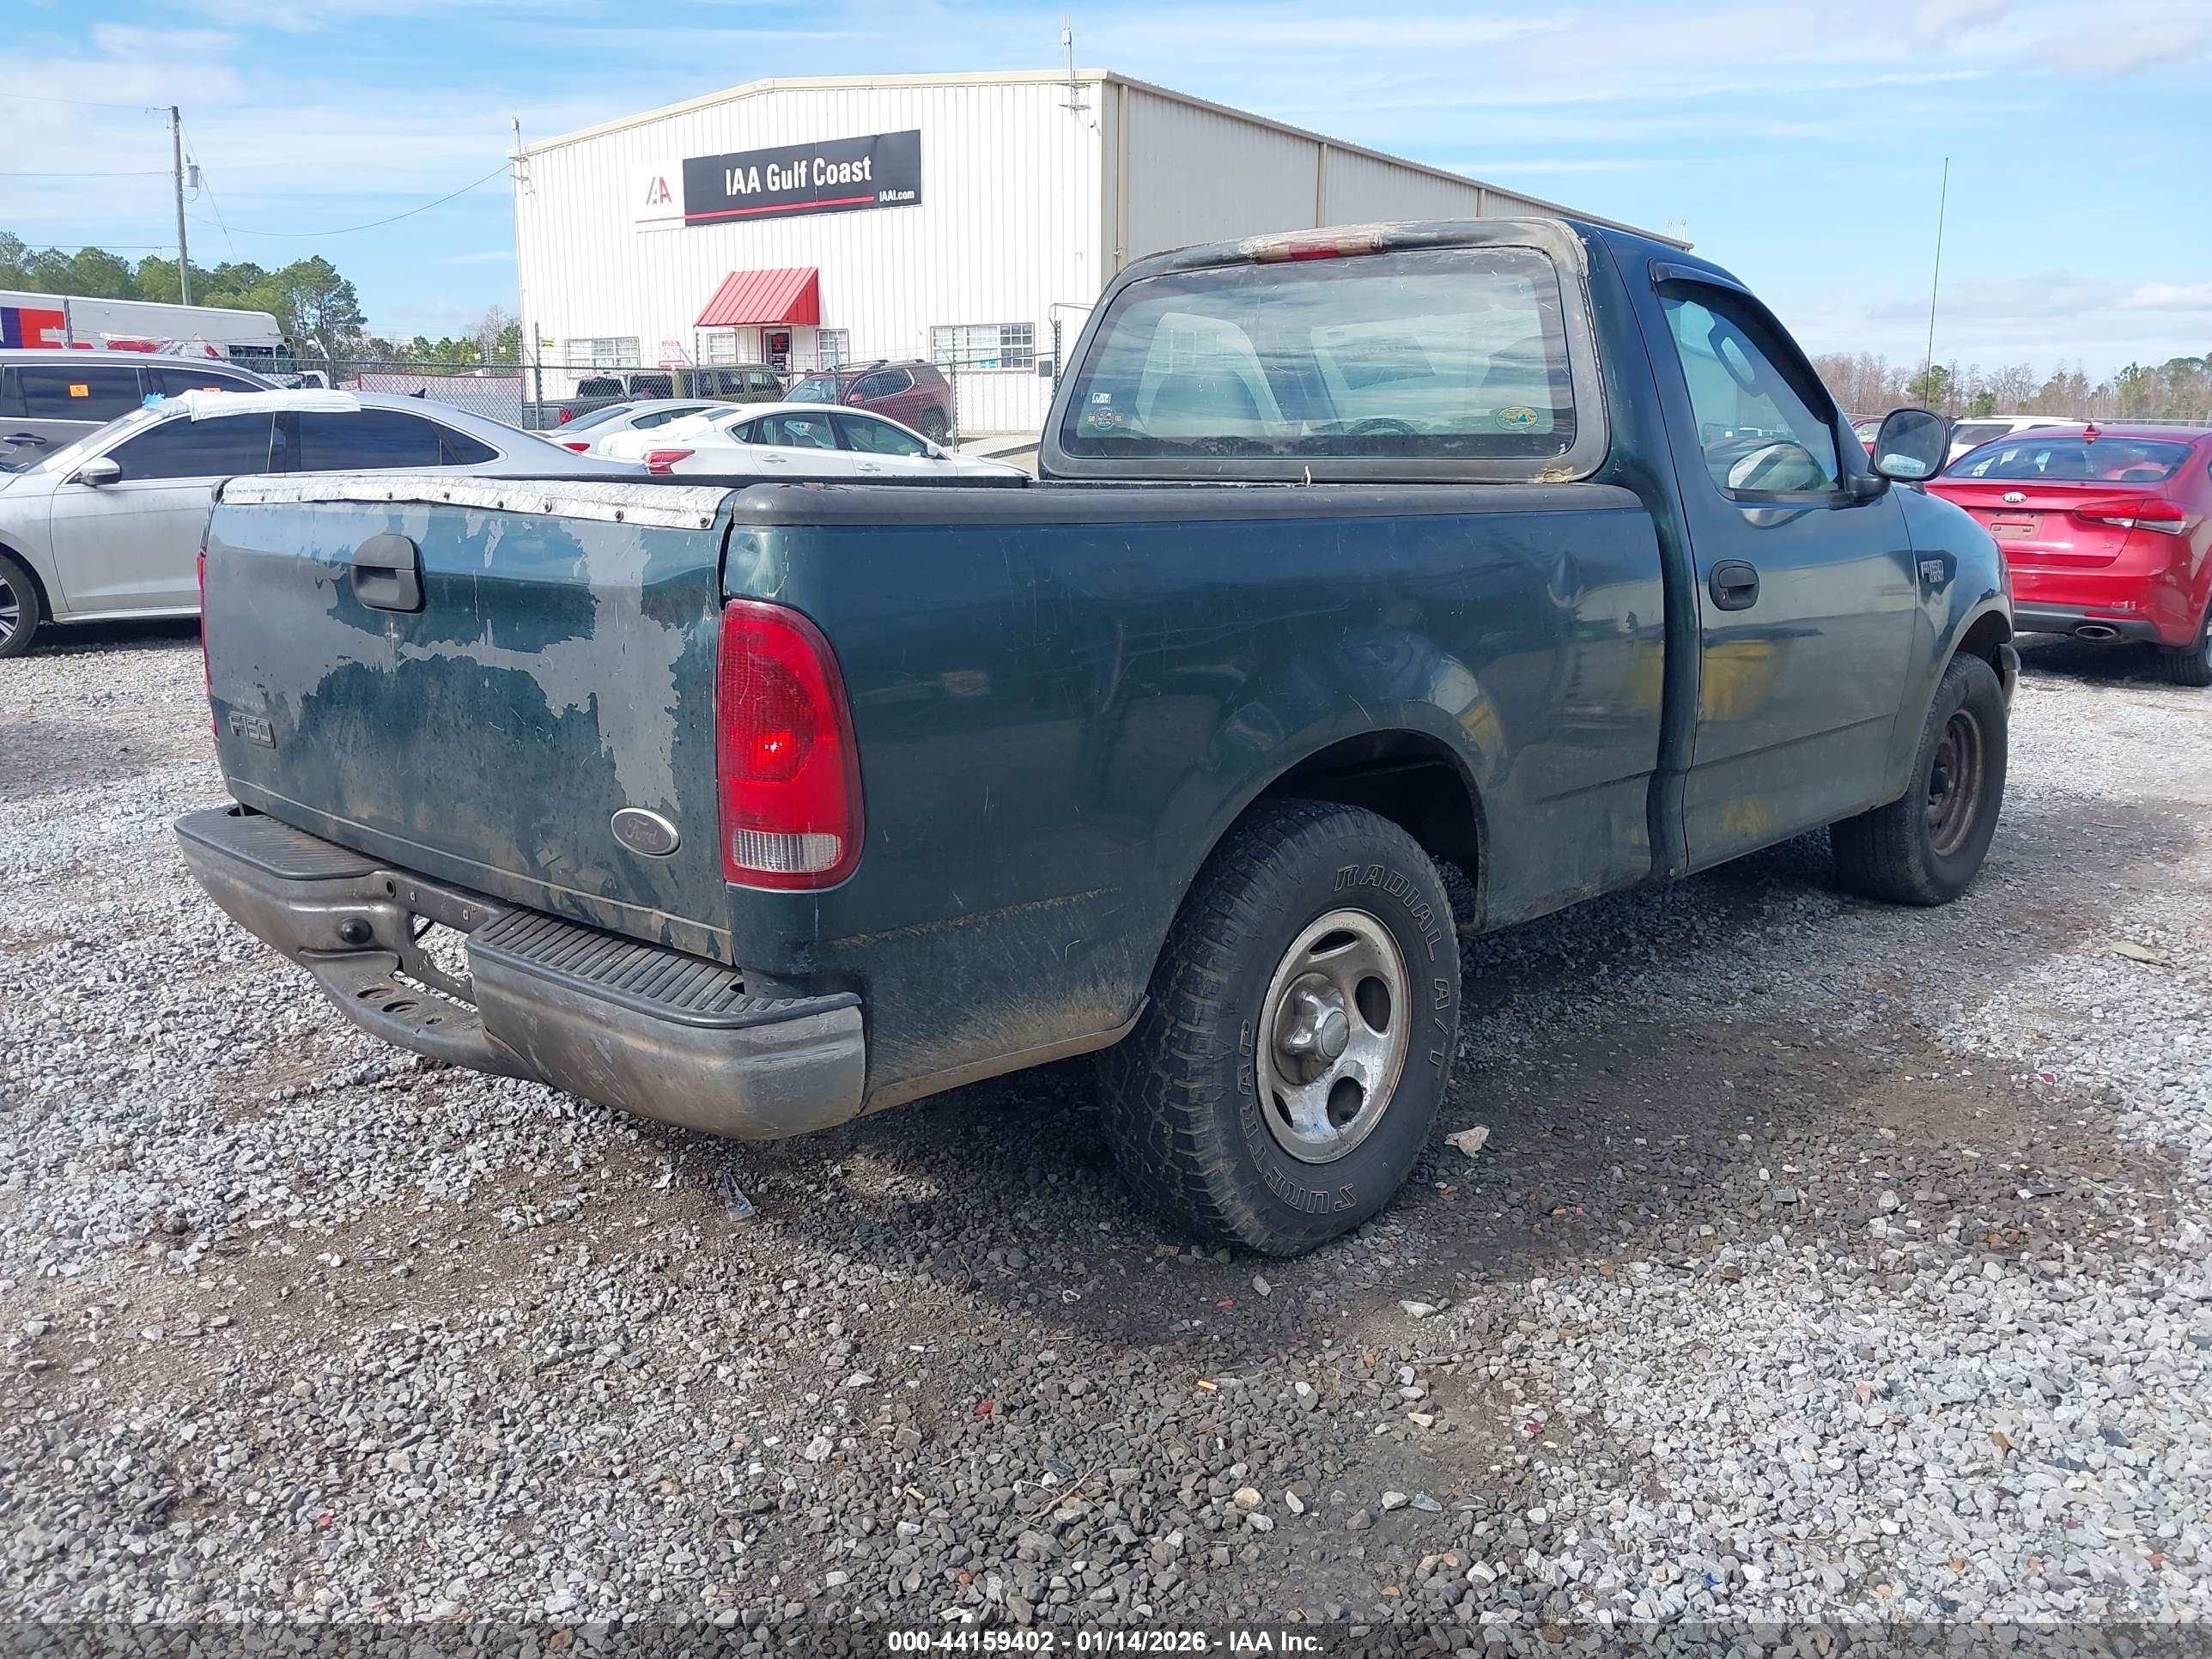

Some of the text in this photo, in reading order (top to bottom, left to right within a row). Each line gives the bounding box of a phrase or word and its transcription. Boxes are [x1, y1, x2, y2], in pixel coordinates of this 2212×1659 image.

[726, 155, 872, 196] IAA Gulf Coast
[879, 189, 915, 203] IAAI.com
[625, 817, 659, 846] Ford
[1334, 865, 1443, 962] RADIAL
[1237, 1018, 1358, 1214] SURETRAC
